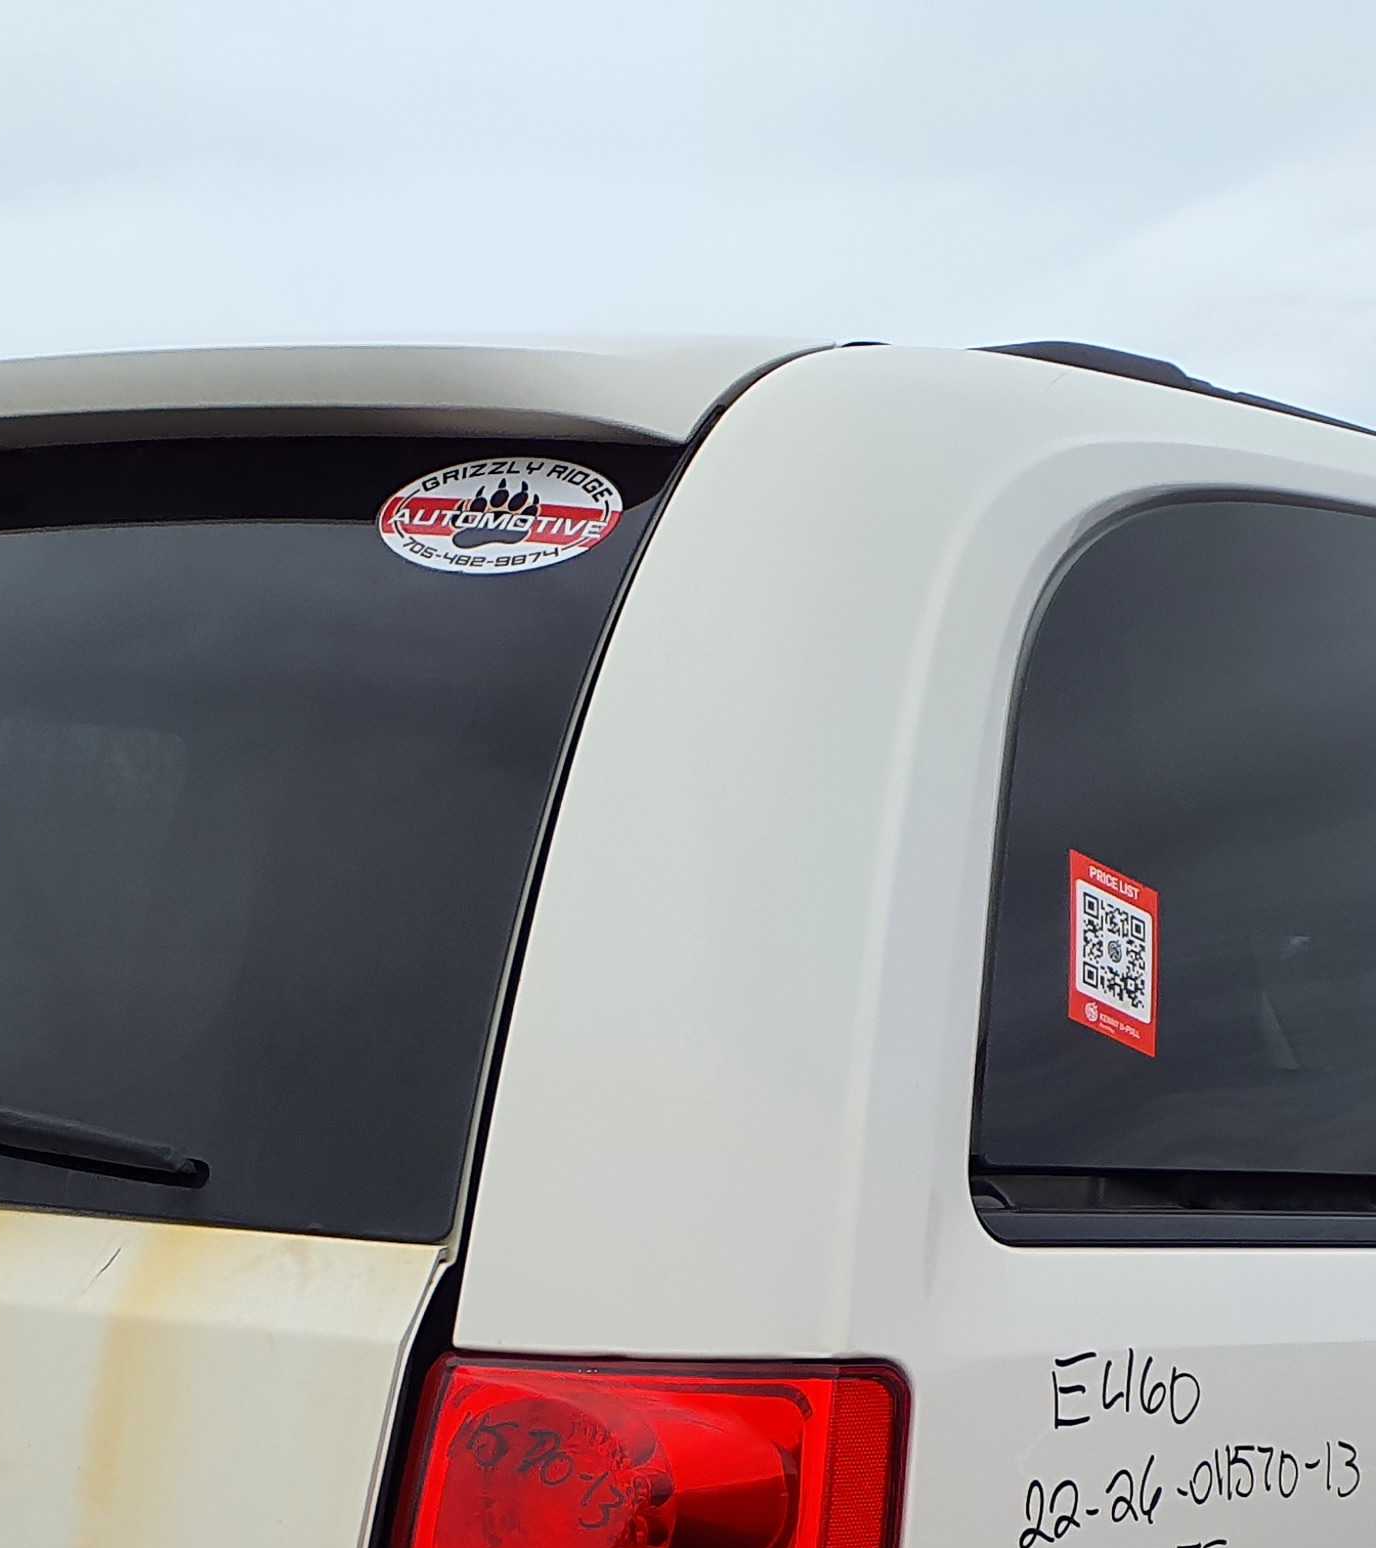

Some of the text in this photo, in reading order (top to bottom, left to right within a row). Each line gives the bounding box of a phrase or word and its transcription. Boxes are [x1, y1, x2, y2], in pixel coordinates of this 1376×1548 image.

[421, 460, 613, 503] GRIZZLY RIDGE
[388, 507, 607, 538] AUTOMOTIVE
[1089, 865, 1141, 901] PRICE LIST
